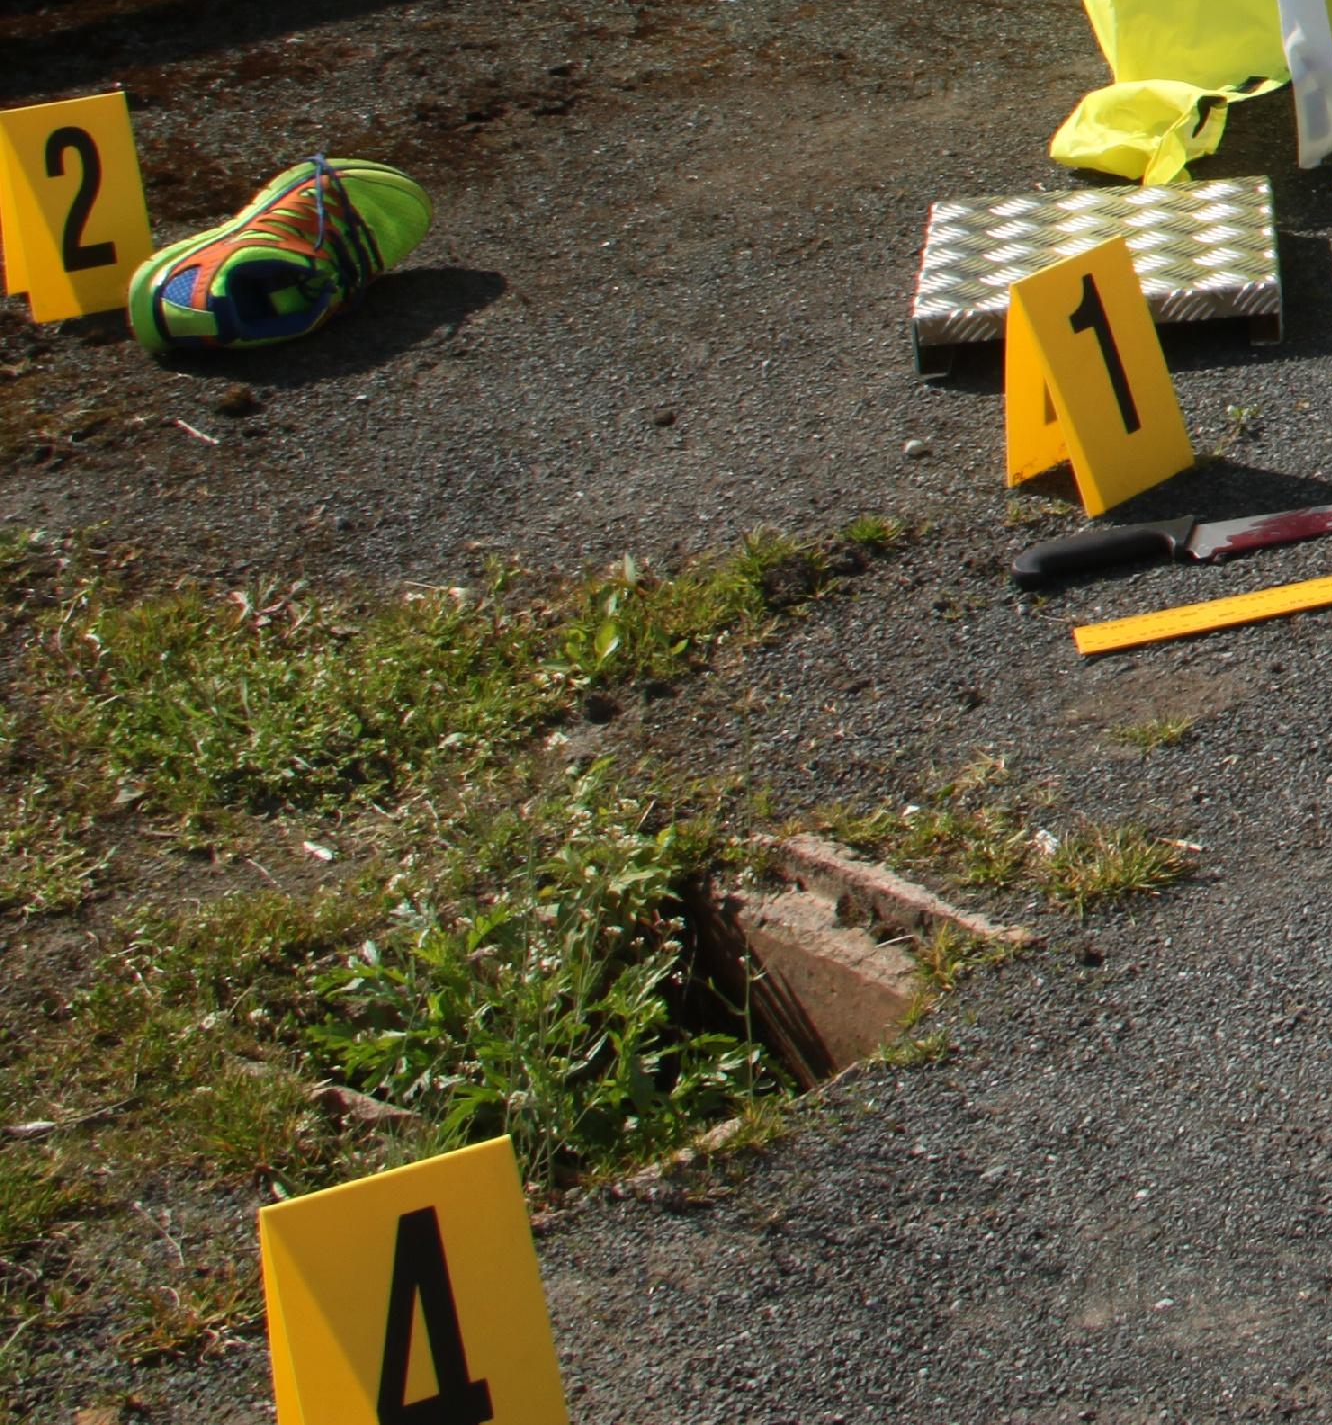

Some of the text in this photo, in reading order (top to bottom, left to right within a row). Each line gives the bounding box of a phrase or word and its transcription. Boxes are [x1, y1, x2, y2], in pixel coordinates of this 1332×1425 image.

[44, 126, 117, 273] 2
[1069, 274, 1140, 435] 1
[376, 1206, 494, 1425] 4
